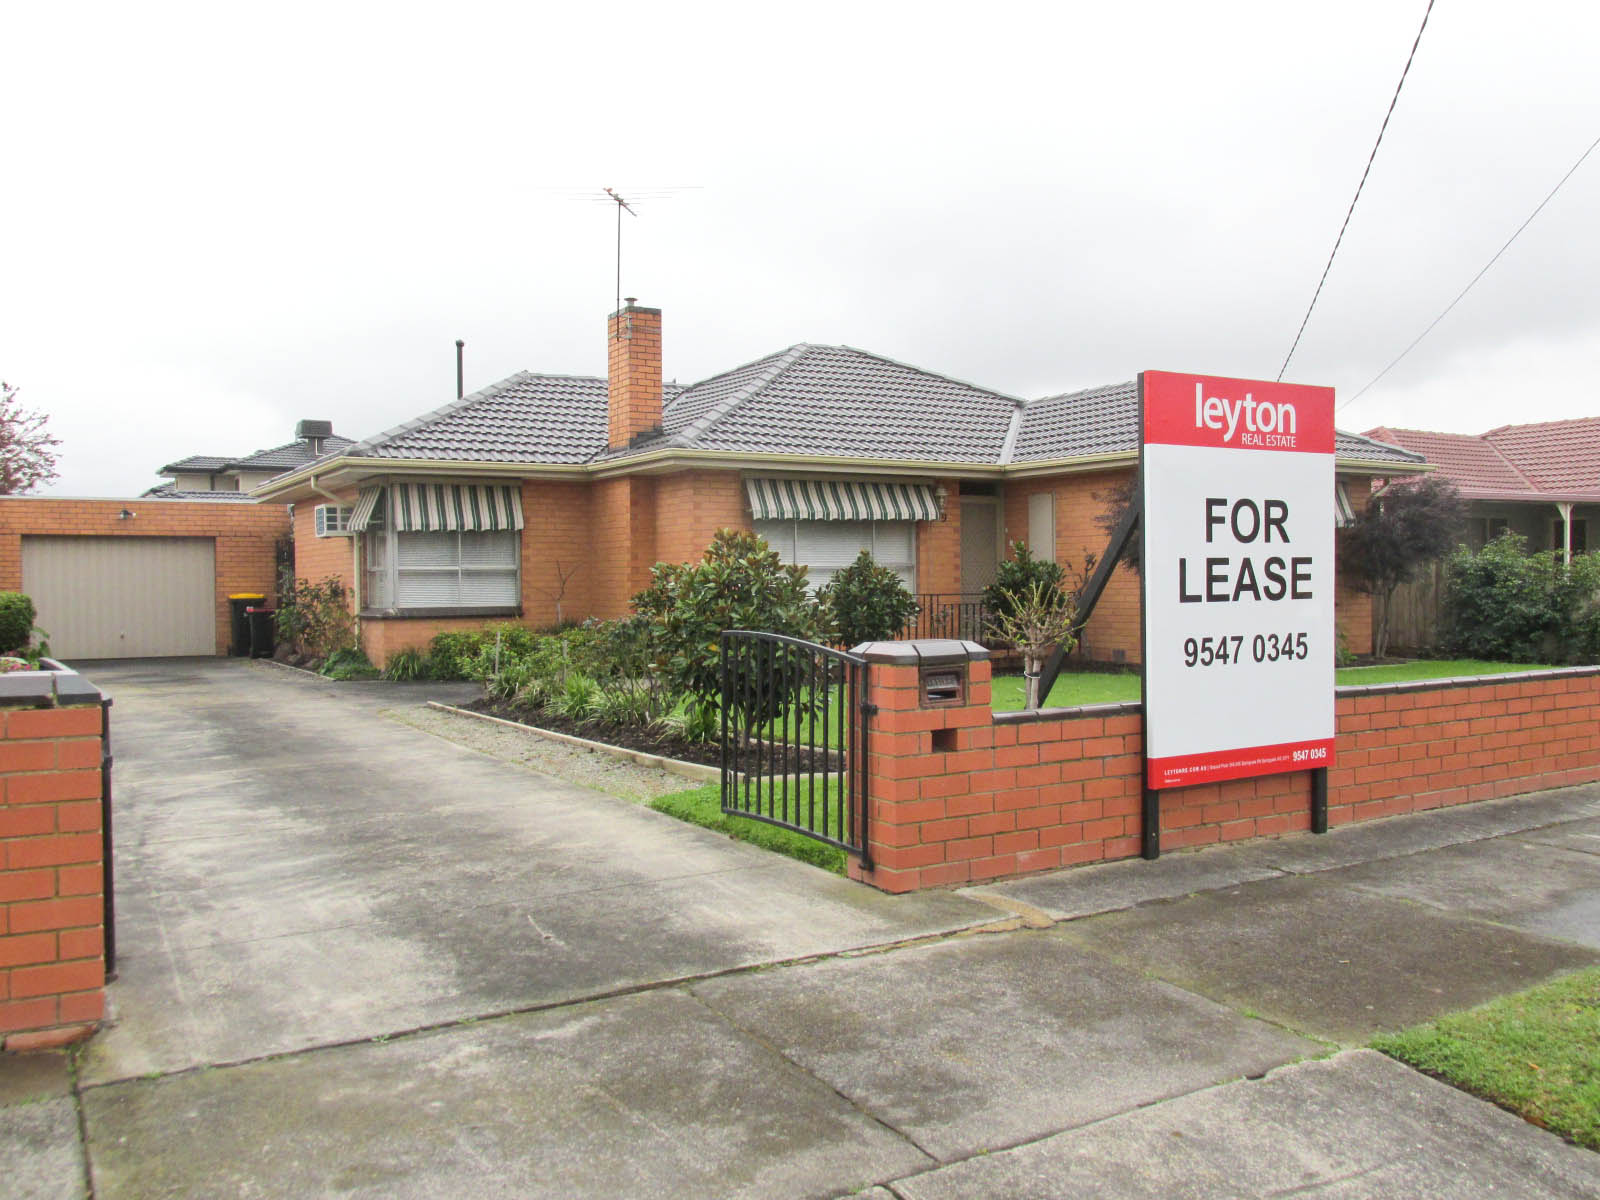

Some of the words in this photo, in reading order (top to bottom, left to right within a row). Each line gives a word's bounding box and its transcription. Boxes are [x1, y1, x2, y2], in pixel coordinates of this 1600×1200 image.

[1195, 383, 1297, 442] leyton
[1241, 432, 1265, 446] REAL
[1266, 434, 1297, 448] ESTATE
[1205, 498, 1291, 544] FOR
[1179, 557, 1313, 604] LEASE
[1184, 635, 1244, 668] 9547
[1252, 632, 1308, 663] 0345
[1292, 750, 1309, 762] 9547
[1310, 748, 1327, 759] 0345
